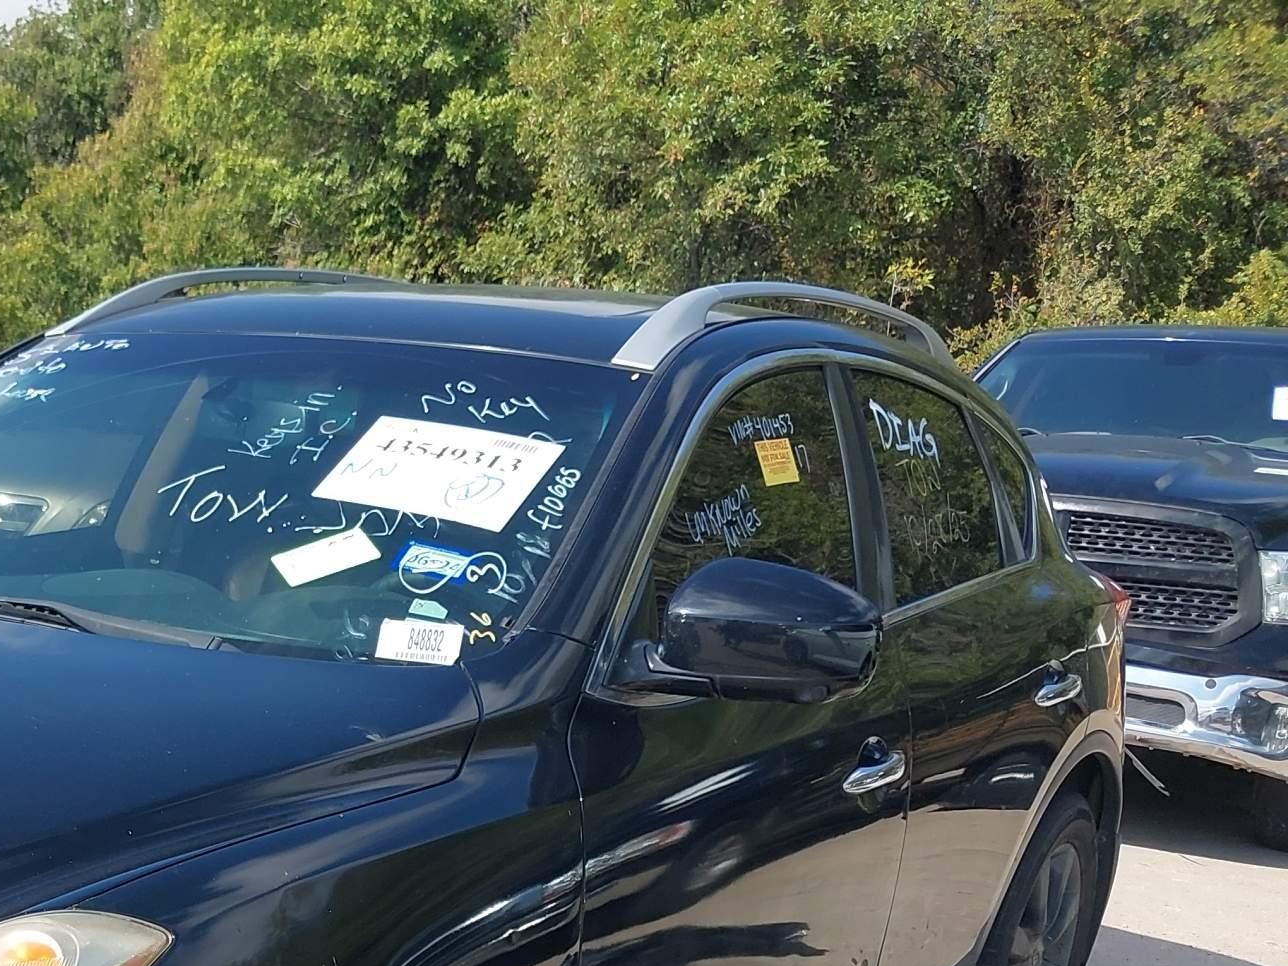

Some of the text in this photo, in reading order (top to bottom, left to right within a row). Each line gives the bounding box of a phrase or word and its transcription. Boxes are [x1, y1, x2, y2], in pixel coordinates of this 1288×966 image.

[421, 380, 476, 414] No
[467, 396, 551, 424] Key
[868, 398, 941, 469] DIAG
[407, 627, 446, 652] 848832
